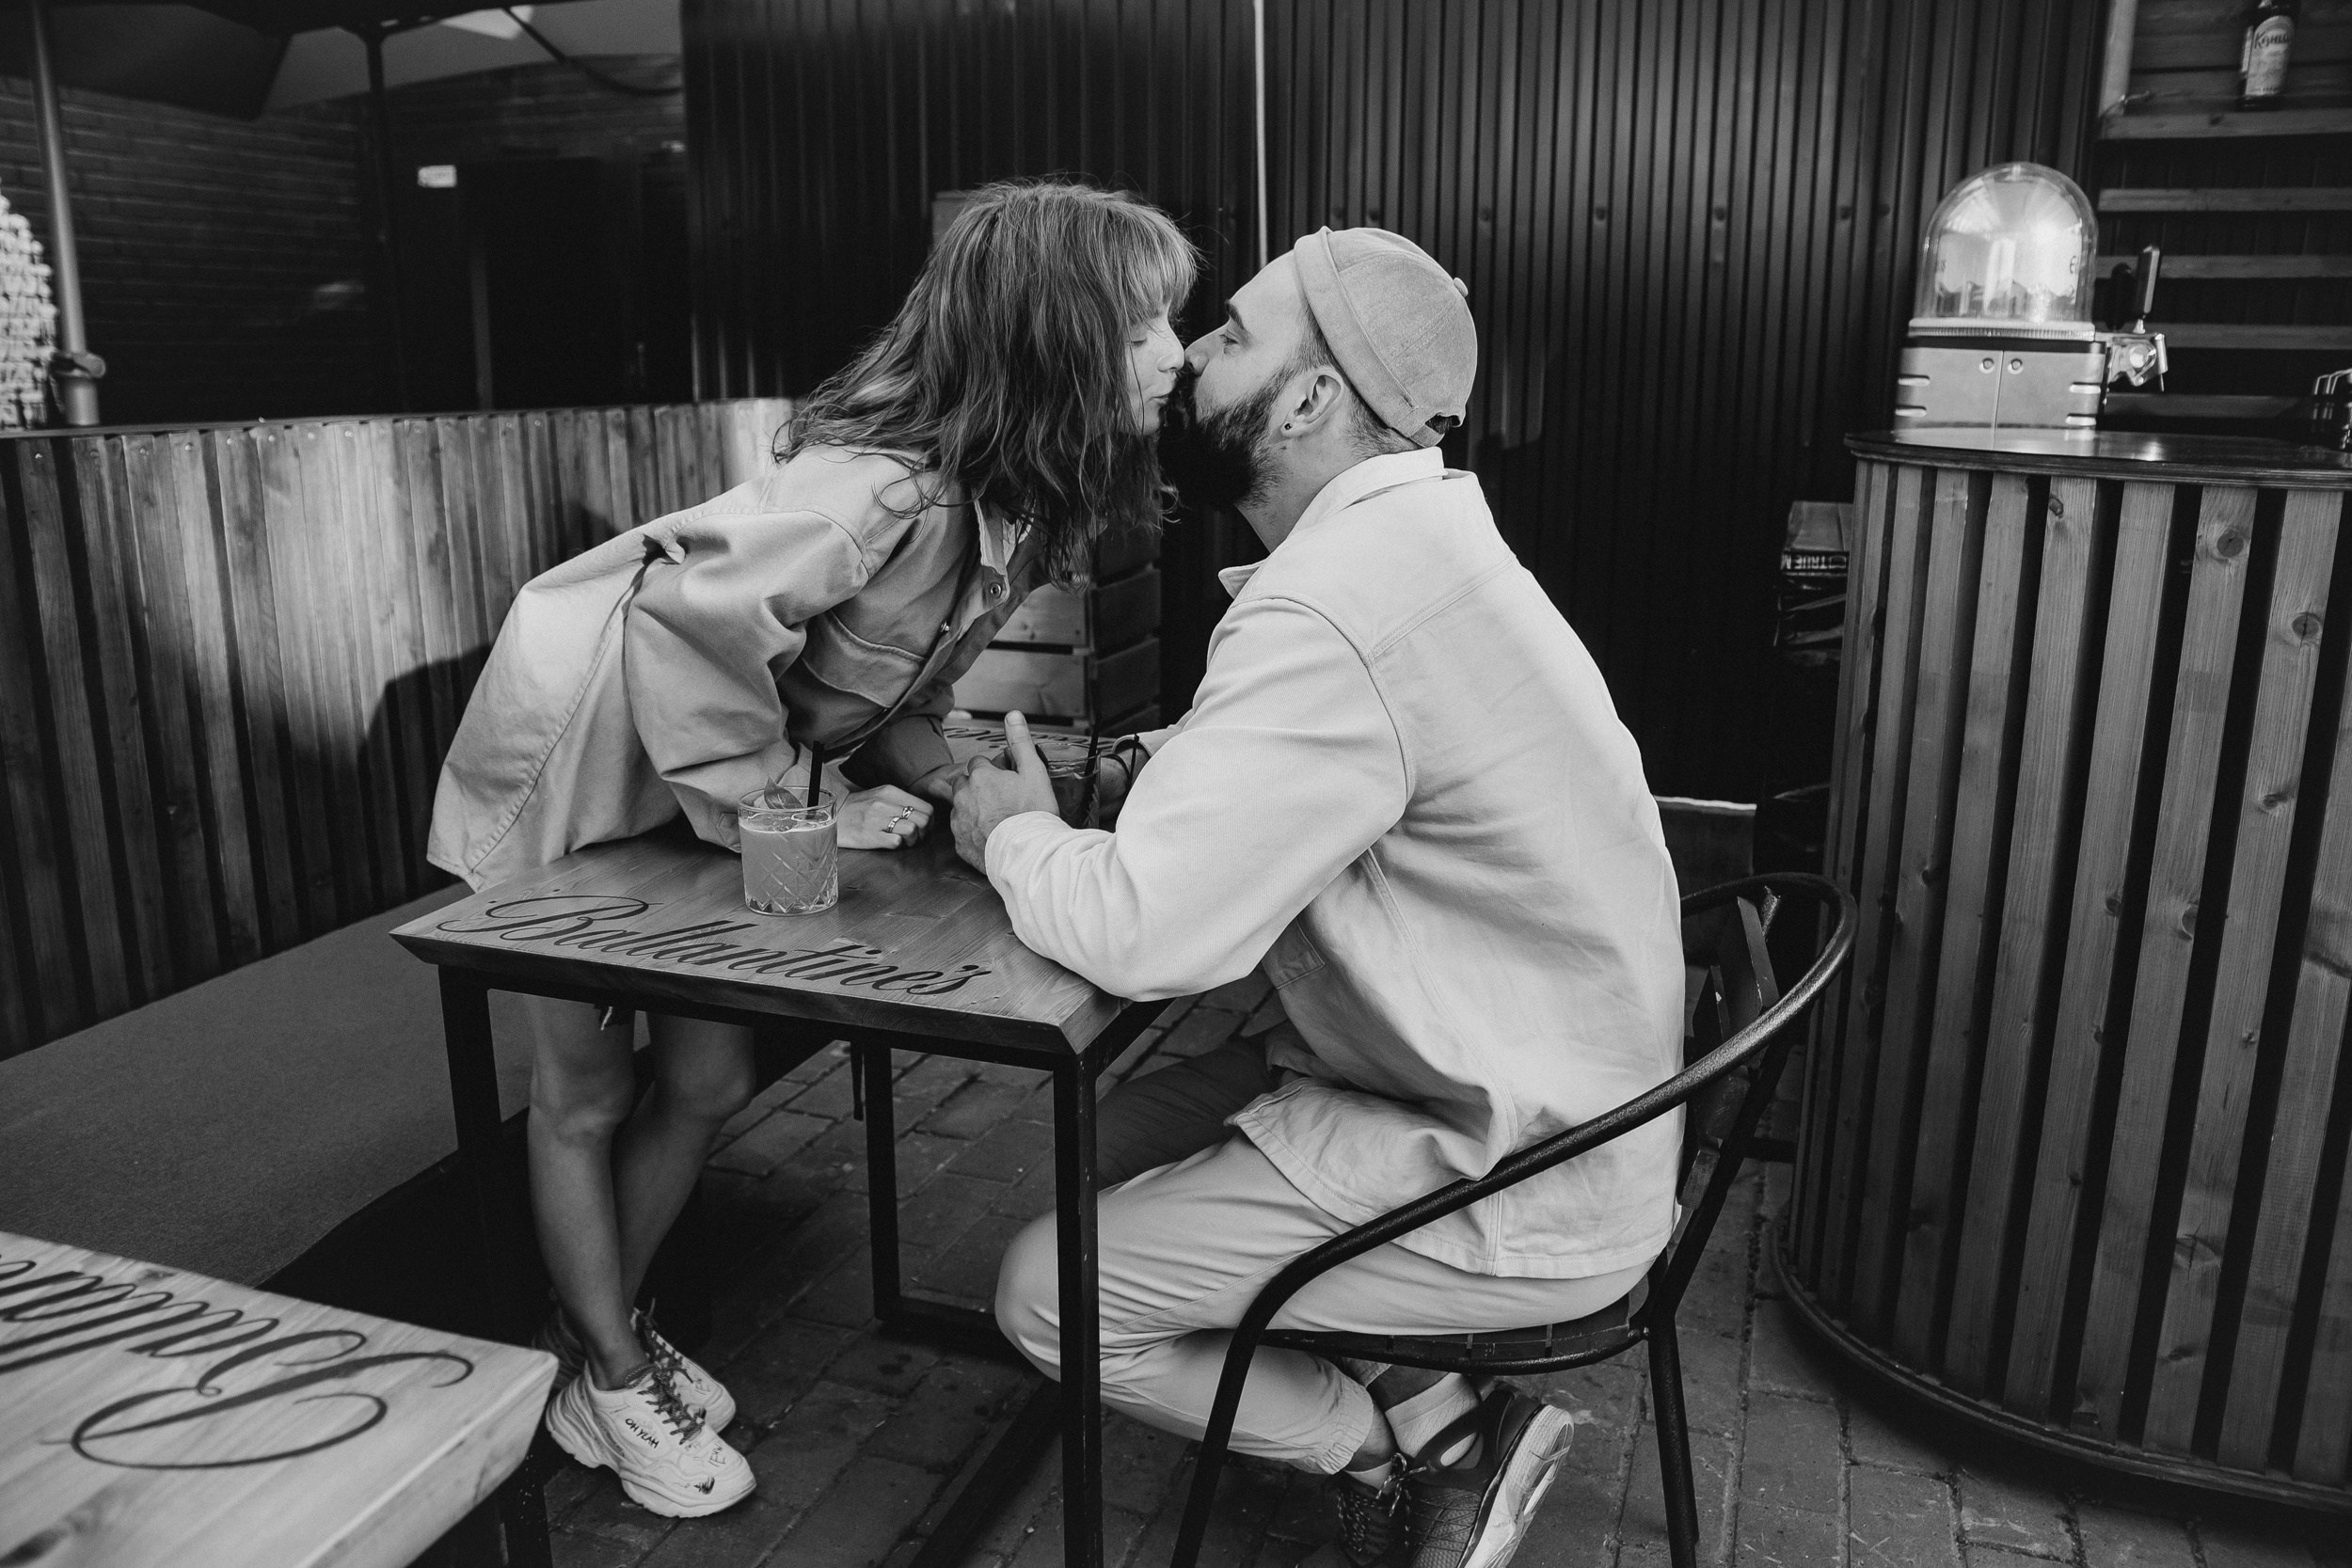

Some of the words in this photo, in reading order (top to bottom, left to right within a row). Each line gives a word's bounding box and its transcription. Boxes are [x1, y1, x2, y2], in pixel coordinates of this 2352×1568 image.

[436, 895, 993, 996] Ballantine's
[625, 1418, 640, 1433] OH
[636, 1429, 660, 1449] YEAH
